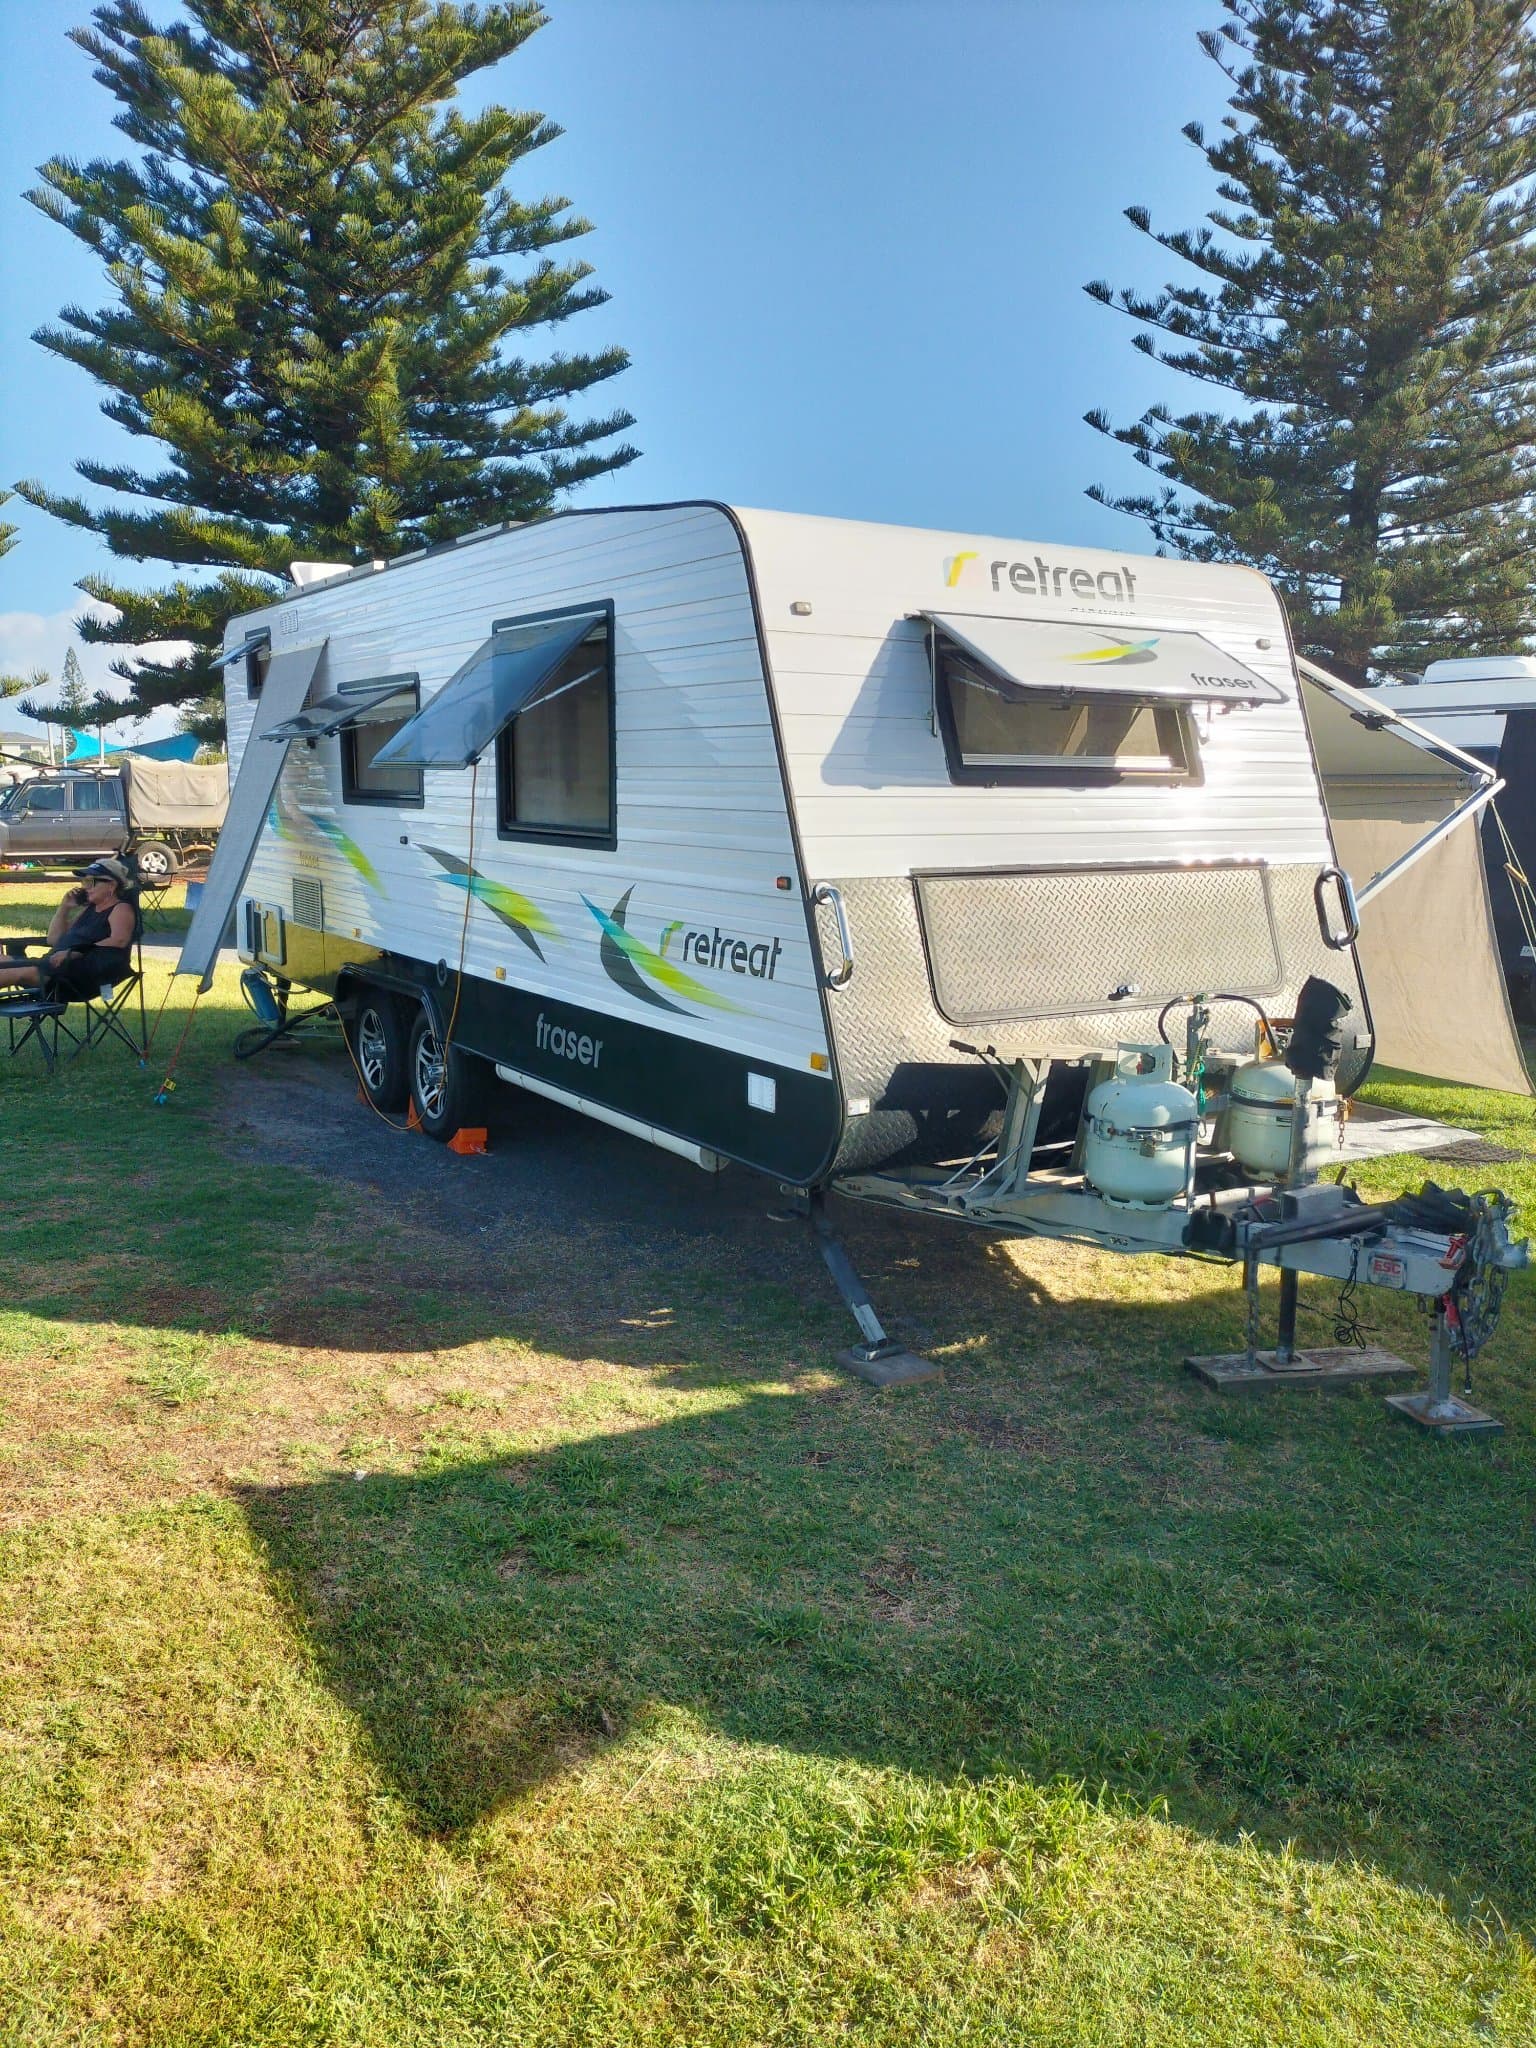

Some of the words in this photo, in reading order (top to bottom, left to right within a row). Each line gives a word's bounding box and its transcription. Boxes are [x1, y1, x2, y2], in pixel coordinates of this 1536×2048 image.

[990, 556, 1137, 602] retreat
[1190, 672, 1256, 689] fraser
[683, 927, 782, 980] retreat
[536, 1013, 603, 1069] fraser
